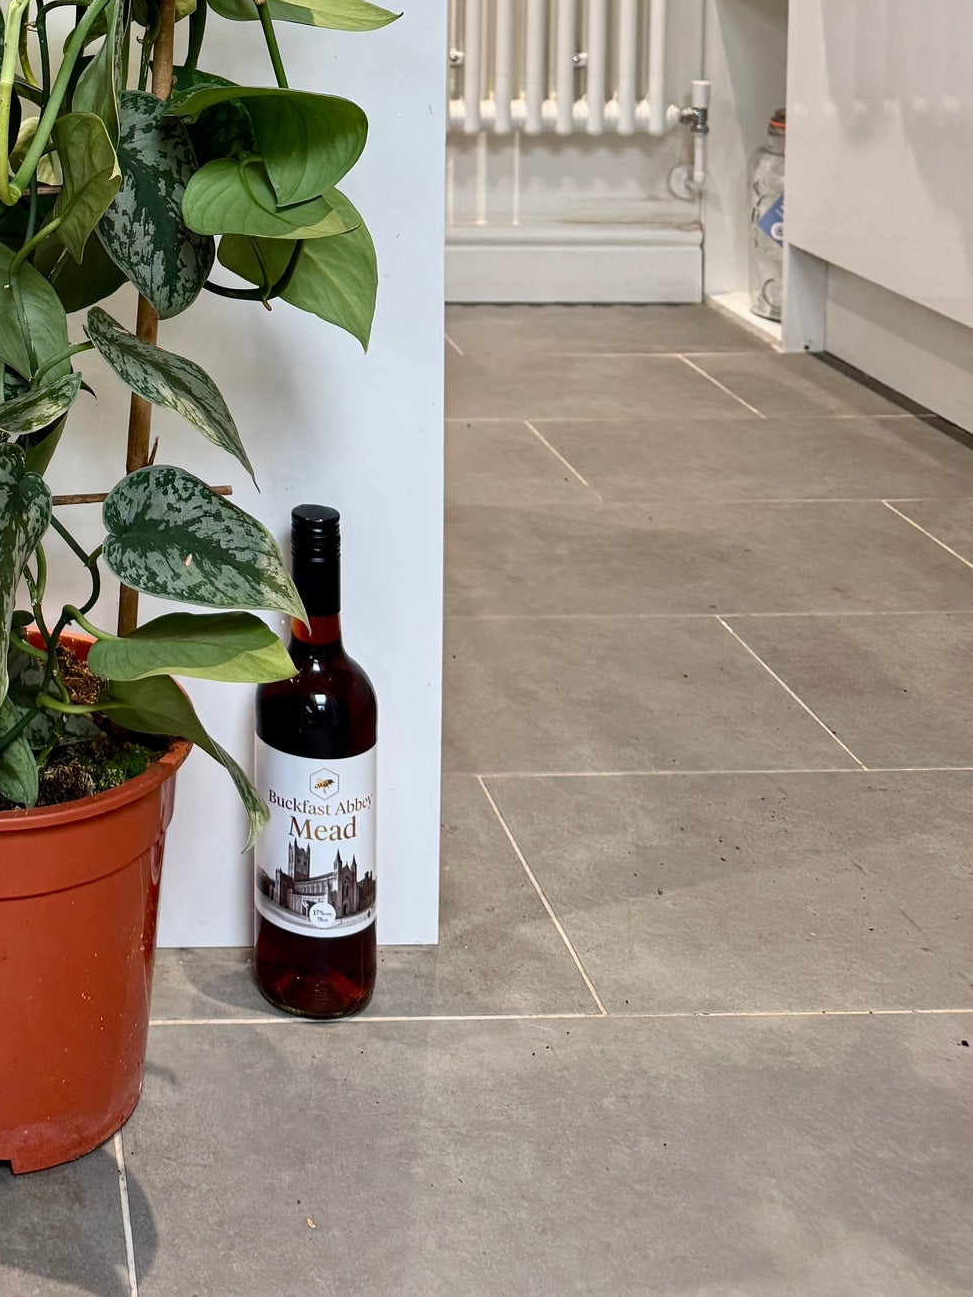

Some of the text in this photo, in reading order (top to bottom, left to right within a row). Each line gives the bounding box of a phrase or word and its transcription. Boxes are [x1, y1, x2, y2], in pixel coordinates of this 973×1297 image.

[268, 789, 373, 816] Buckfast Abbey
[288, 815, 357, 842] Mead
